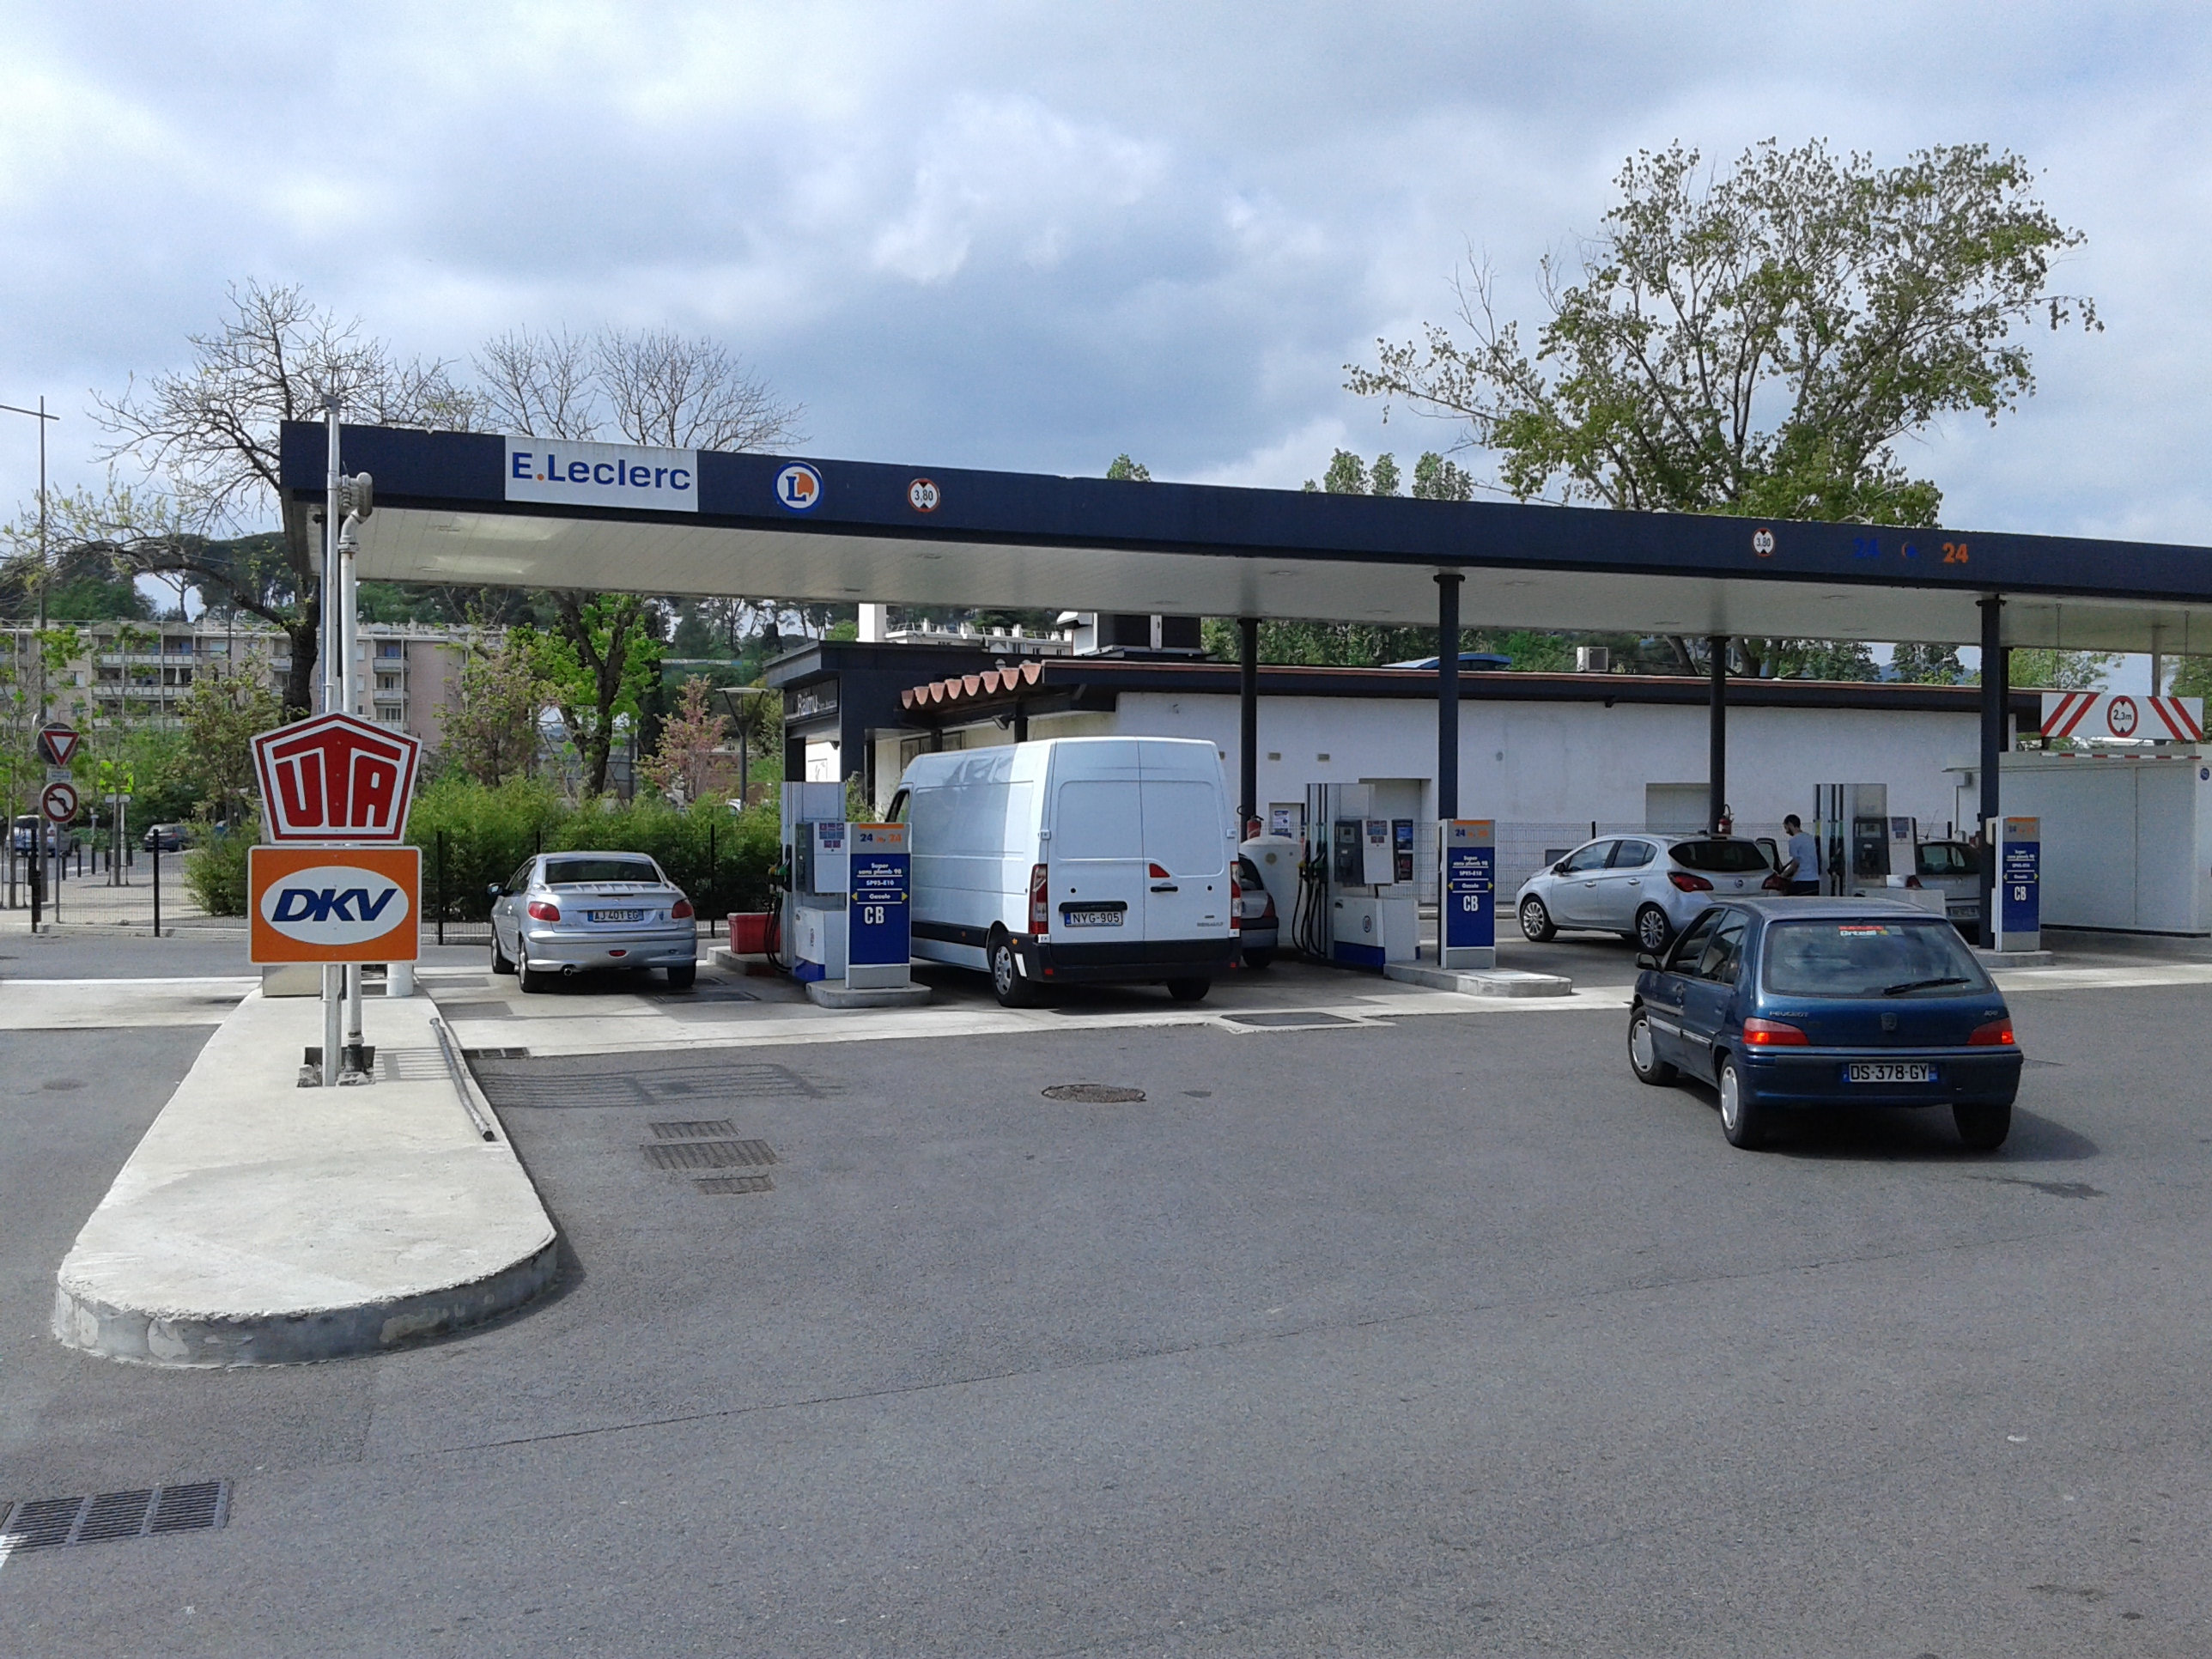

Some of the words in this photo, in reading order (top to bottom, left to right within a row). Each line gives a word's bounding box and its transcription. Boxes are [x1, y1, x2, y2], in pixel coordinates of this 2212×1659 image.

[512, 451, 690, 490] E.Leclerc
[914, 489, 933, 501] 3,80
[1853, 538, 1881, 558] 24
[1942, 542, 1969, 563] 24
[271, 726, 404, 828] UTA
[860, 833, 873, 842] 24
[871, 862, 889, 871] Super
[2014, 885, 2027, 901] CB
[270, 888, 398, 922] DKV
[1462, 895, 1479, 912] CB
[864, 906, 884, 925] CB
[1073, 912, 1120, 923] NYG-905
[1850, 1065, 1928, 1080] DS-378-GY
